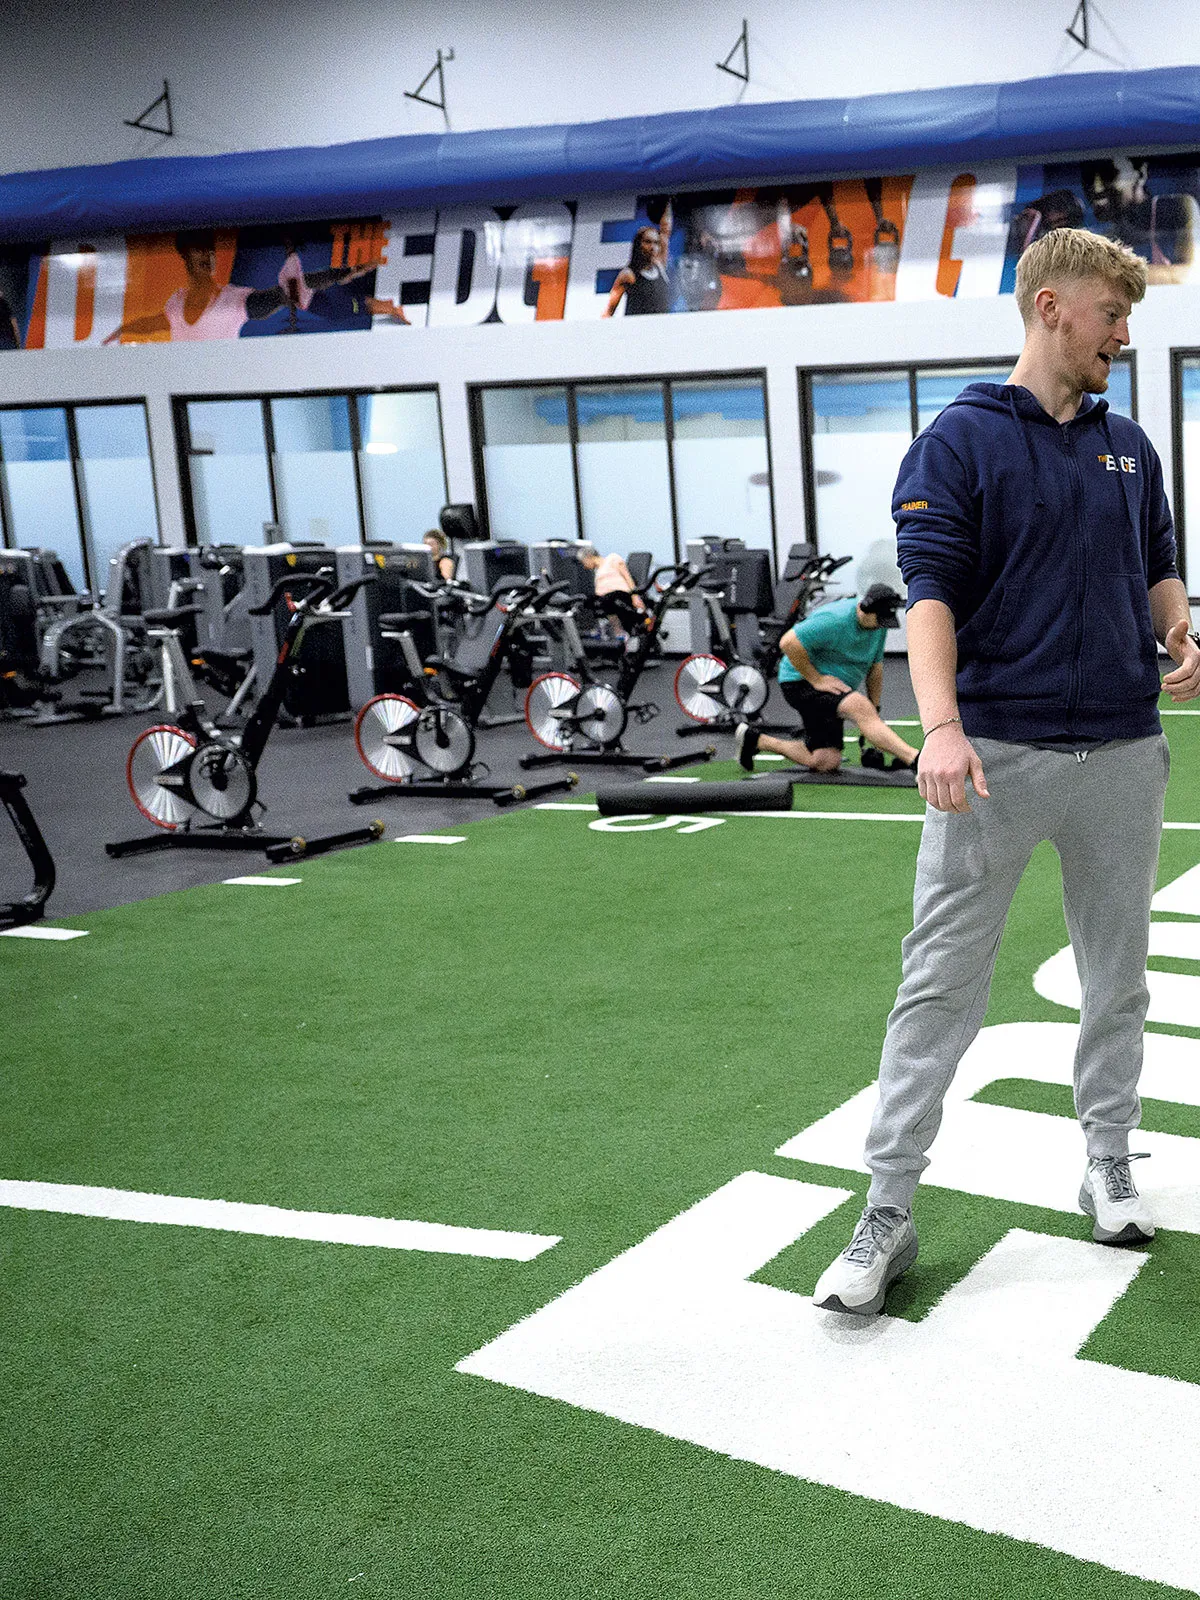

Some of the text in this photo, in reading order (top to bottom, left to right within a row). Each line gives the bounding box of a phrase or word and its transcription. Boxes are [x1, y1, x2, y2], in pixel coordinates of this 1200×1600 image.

[328, 196, 638, 328] THE EDGE
[1106, 454, 1136, 474] EGE
